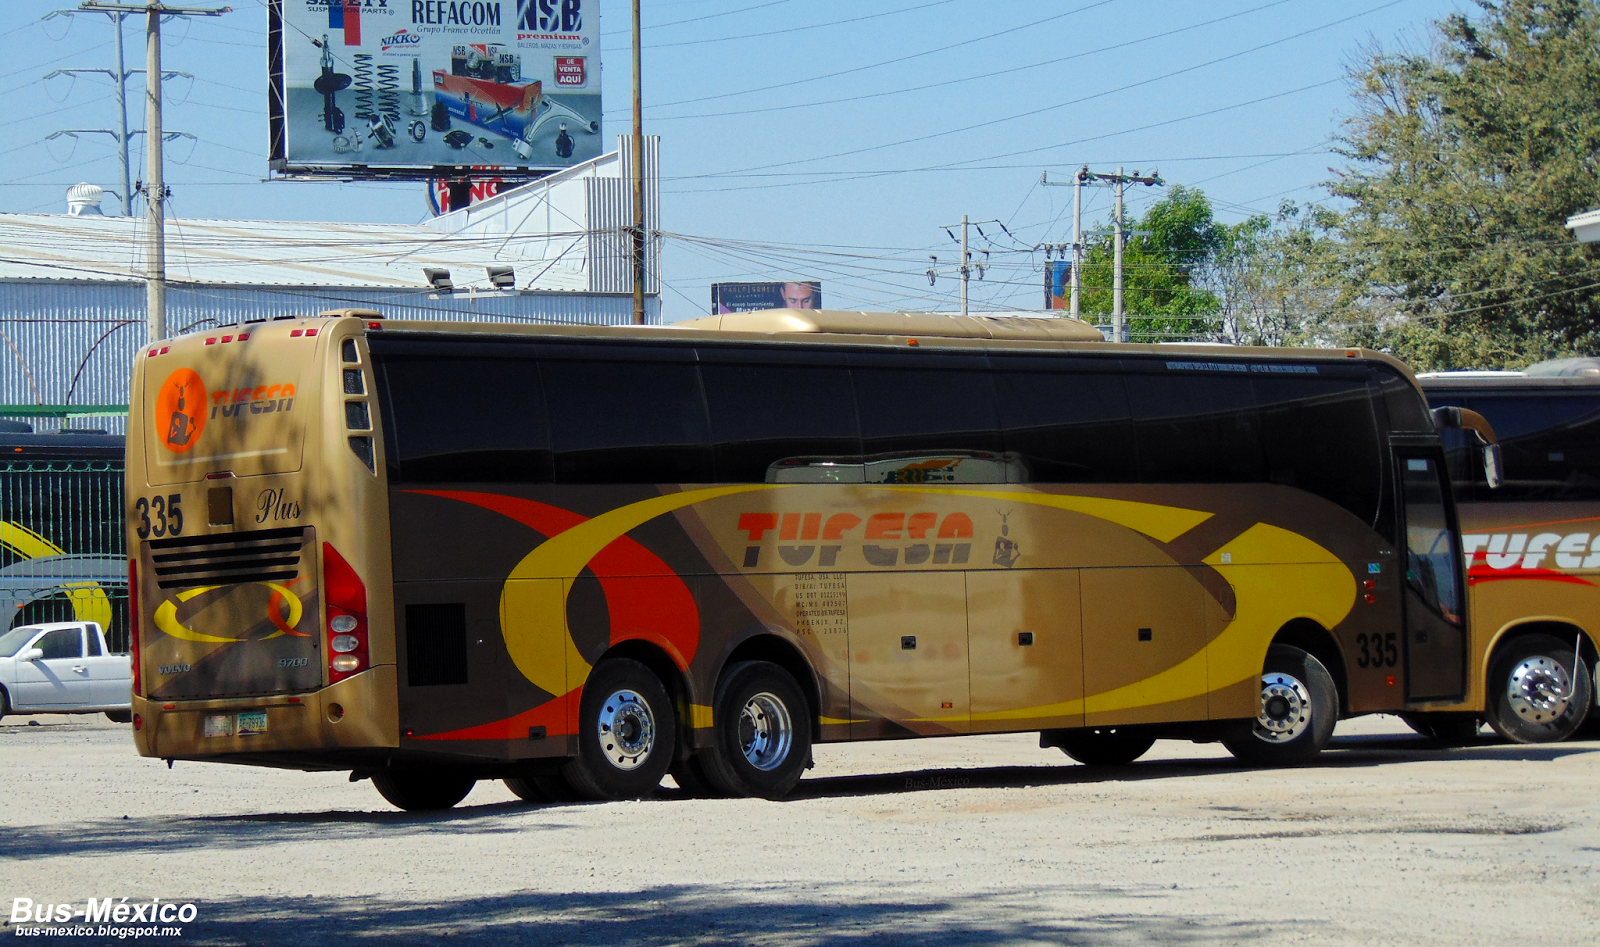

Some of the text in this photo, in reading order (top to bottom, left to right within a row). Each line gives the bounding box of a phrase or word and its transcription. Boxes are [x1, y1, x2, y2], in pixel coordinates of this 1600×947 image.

[411, 0, 501, 26] REFACOM
[516, 0, 583, 32] NSB
[381, 34, 421, 46] NIKKO
[416, 25, 501, 35] Grupo Franco Ocotlán
[500, 53, 514, 64] NSB
[560, 75, 582, 84] AQUÍ
[210, 382, 297, 420] TUFESA
[135, 493, 184, 539] 335
[255, 487, 302, 524] Plus
[737, 512, 974, 568] TUFESA
[1356, 632, 1398, 669] 335
[157, 664, 191, 675] VOLVO
